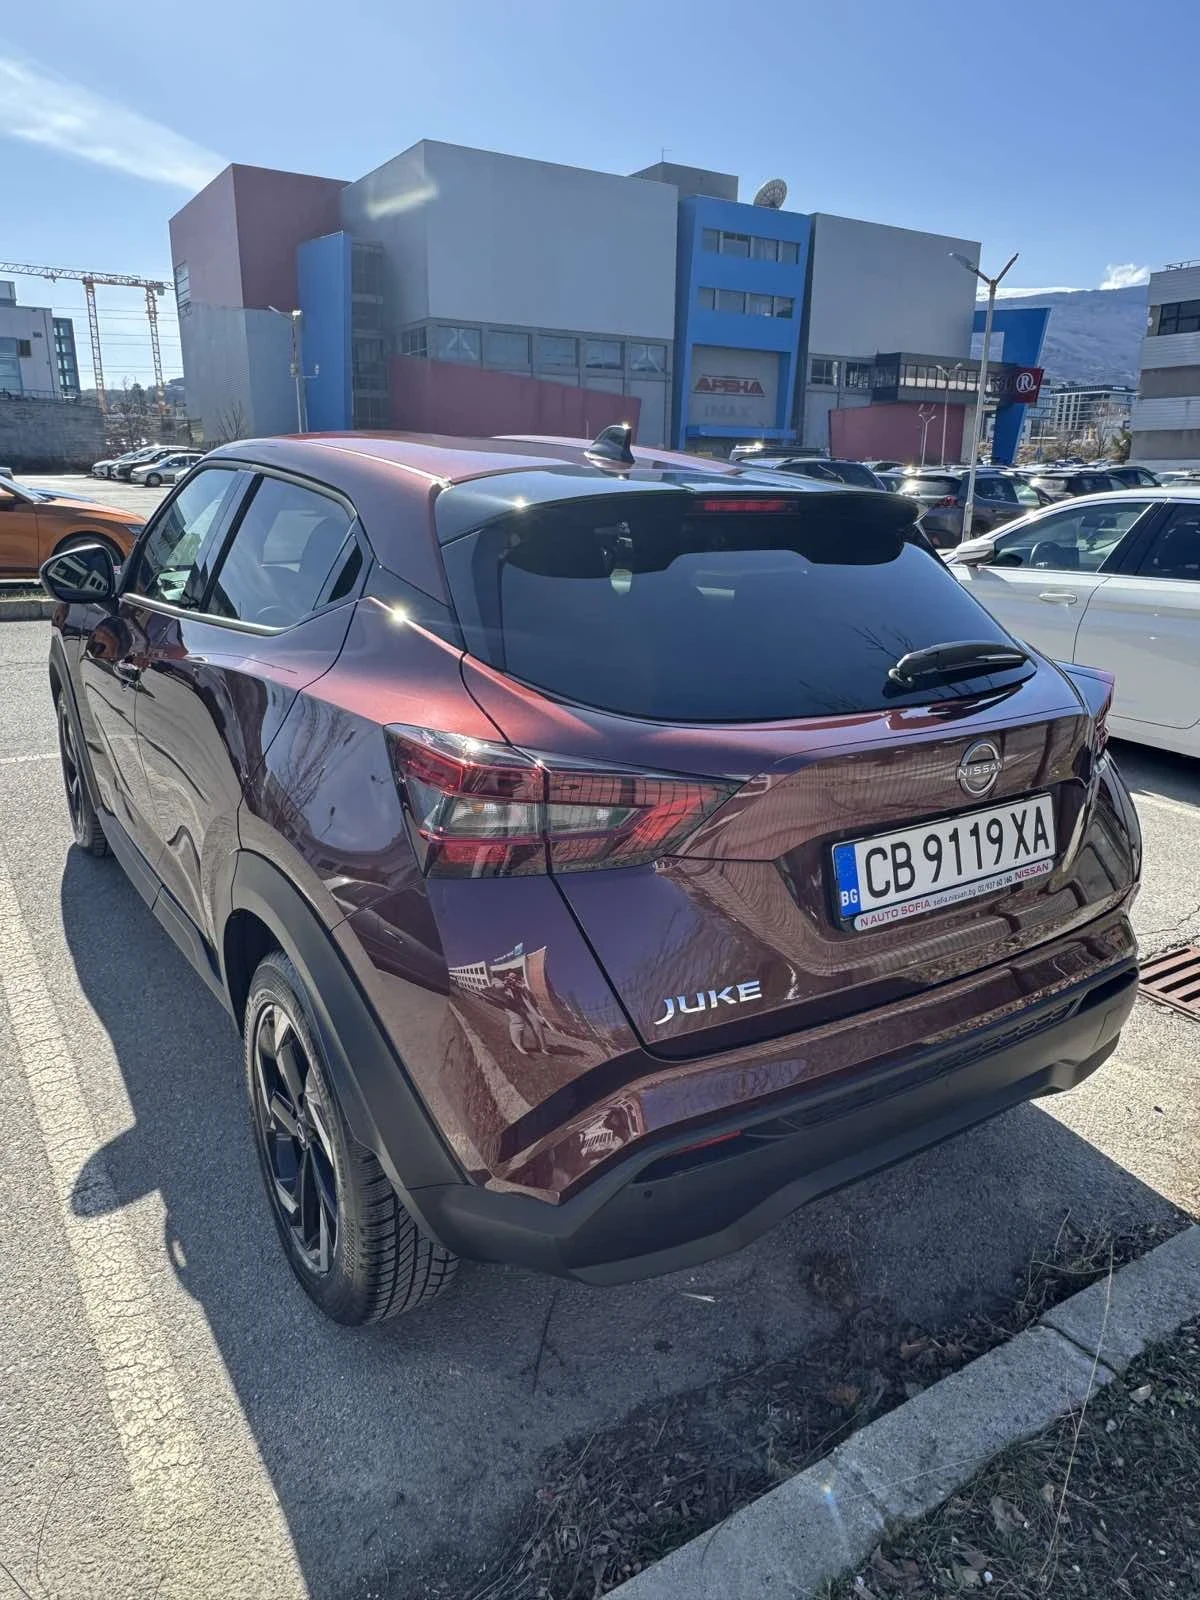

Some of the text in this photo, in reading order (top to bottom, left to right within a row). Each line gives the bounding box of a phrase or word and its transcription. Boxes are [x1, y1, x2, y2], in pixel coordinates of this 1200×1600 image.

[959, 761, 1002, 777] NISSAN
[865, 806, 1050, 899] CB 9119 XA
[841, 888, 858, 907] BG
[901, 900, 931, 915] SOFIA
[1014, 862, 1050, 881] NISSAN
[654, 980, 763, 1026] JUKE
